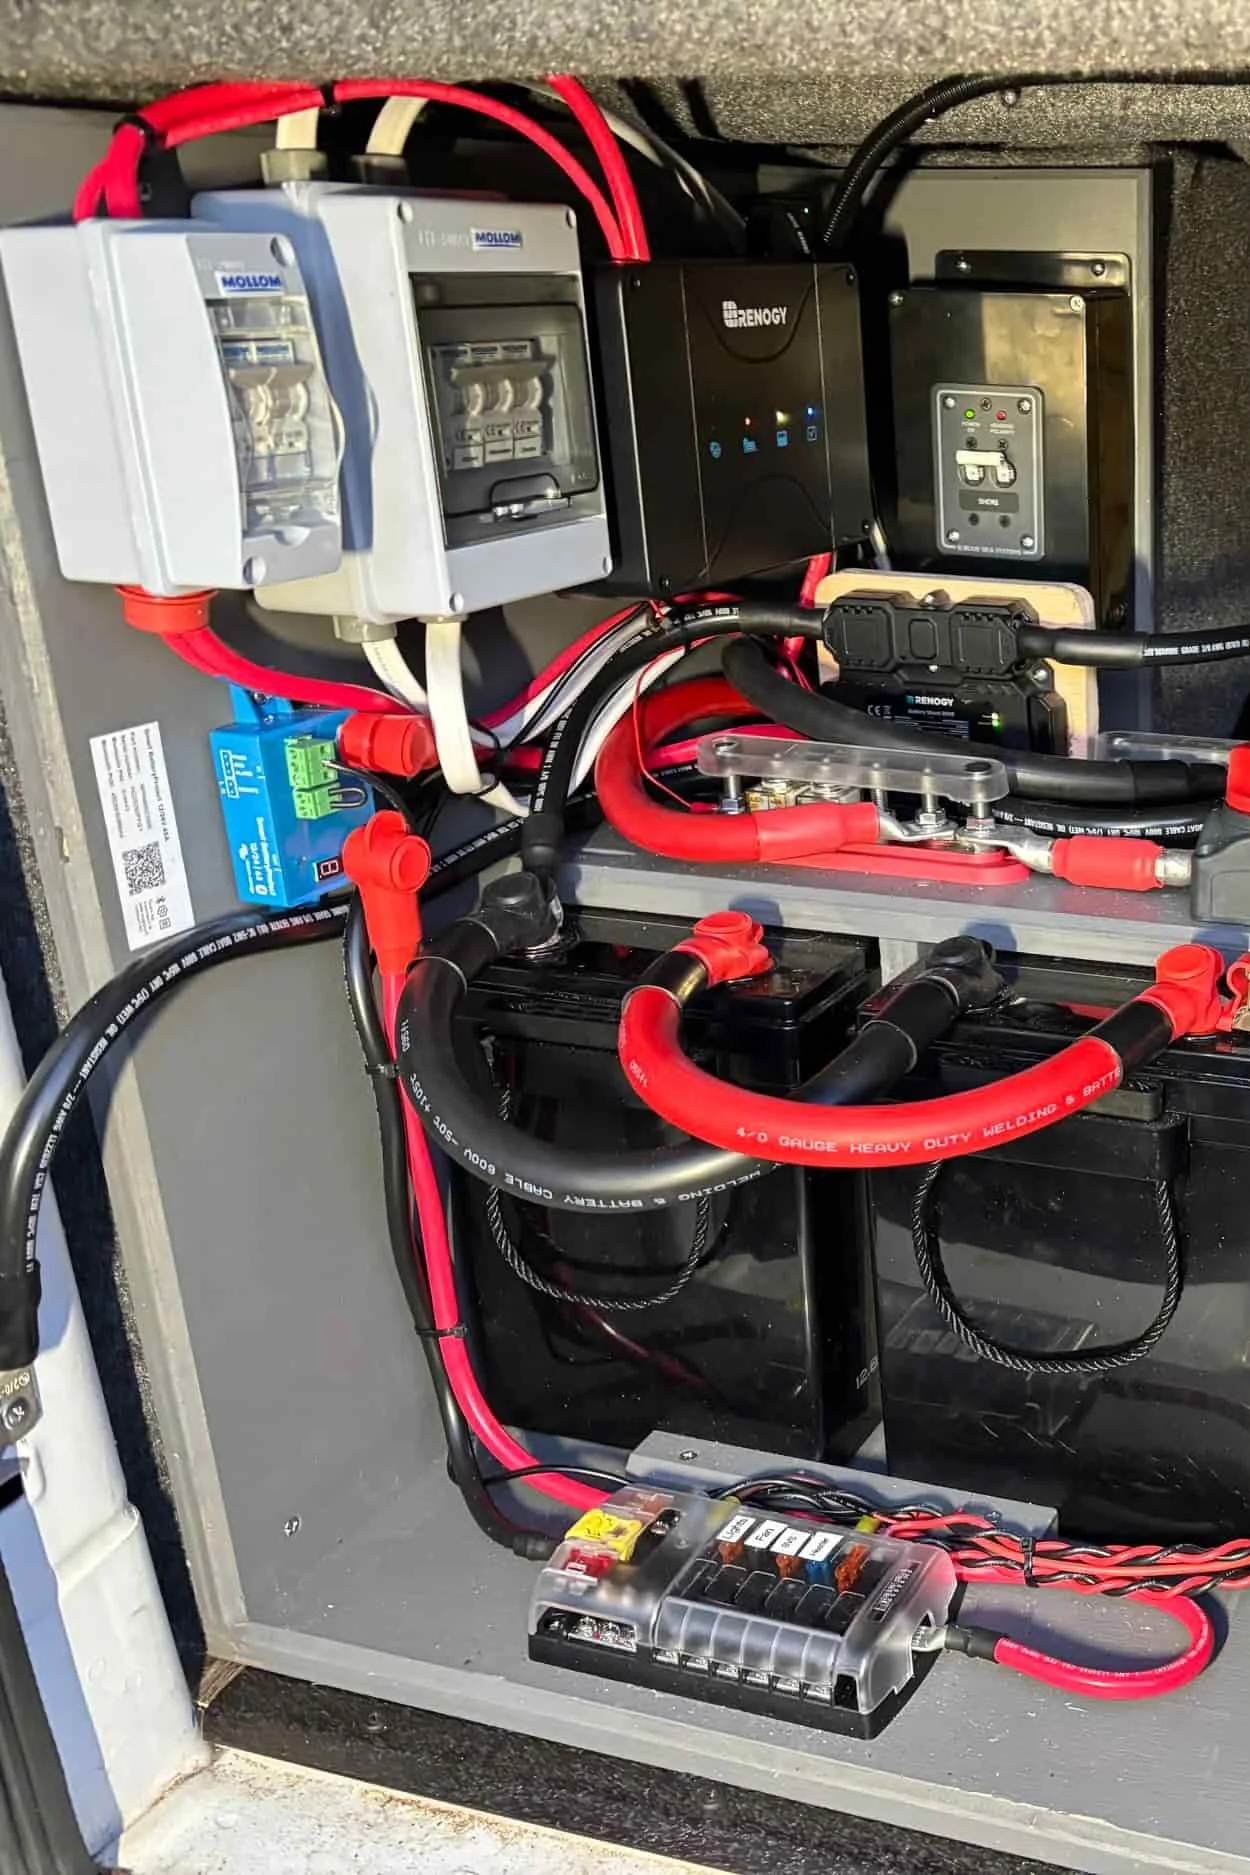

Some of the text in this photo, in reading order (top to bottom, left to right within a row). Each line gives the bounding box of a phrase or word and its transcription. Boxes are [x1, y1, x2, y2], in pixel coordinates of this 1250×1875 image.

[475, 231, 522, 243] MOLLOM
[221, 275, 285, 290] MOLLOM
[738, 307, 787, 328] RENOGY
[915, 696, 954, 707] RENOGY
[1165, 824, 1184, 832] CABLE
[196, 941, 217, 959] CABLE
[104, 1023, 119, 1039] OIL
[78, 1037, 109, 1079] RESISTANT
[53, 1109, 68, 1132] AWG
[736, 1128, 769, 1144] 4/0
[778, 1136, 838, 1152] GAUGE
[849, 1141, 912, 1155] HEAVY
[923, 1132, 973, 1151] DUTY
[983, 1103, 1057, 1138] WELDING
[1065, 1095, 1075, 1106] &
[463, 1148, 497, 1176] 600V
[503, 1173, 554, 1201] CABLE
[677, 1169, 762, 1203] WELDING
[563, 1194, 644, 1209] BATTERY
[756, 1528, 775, 1542] Fan
